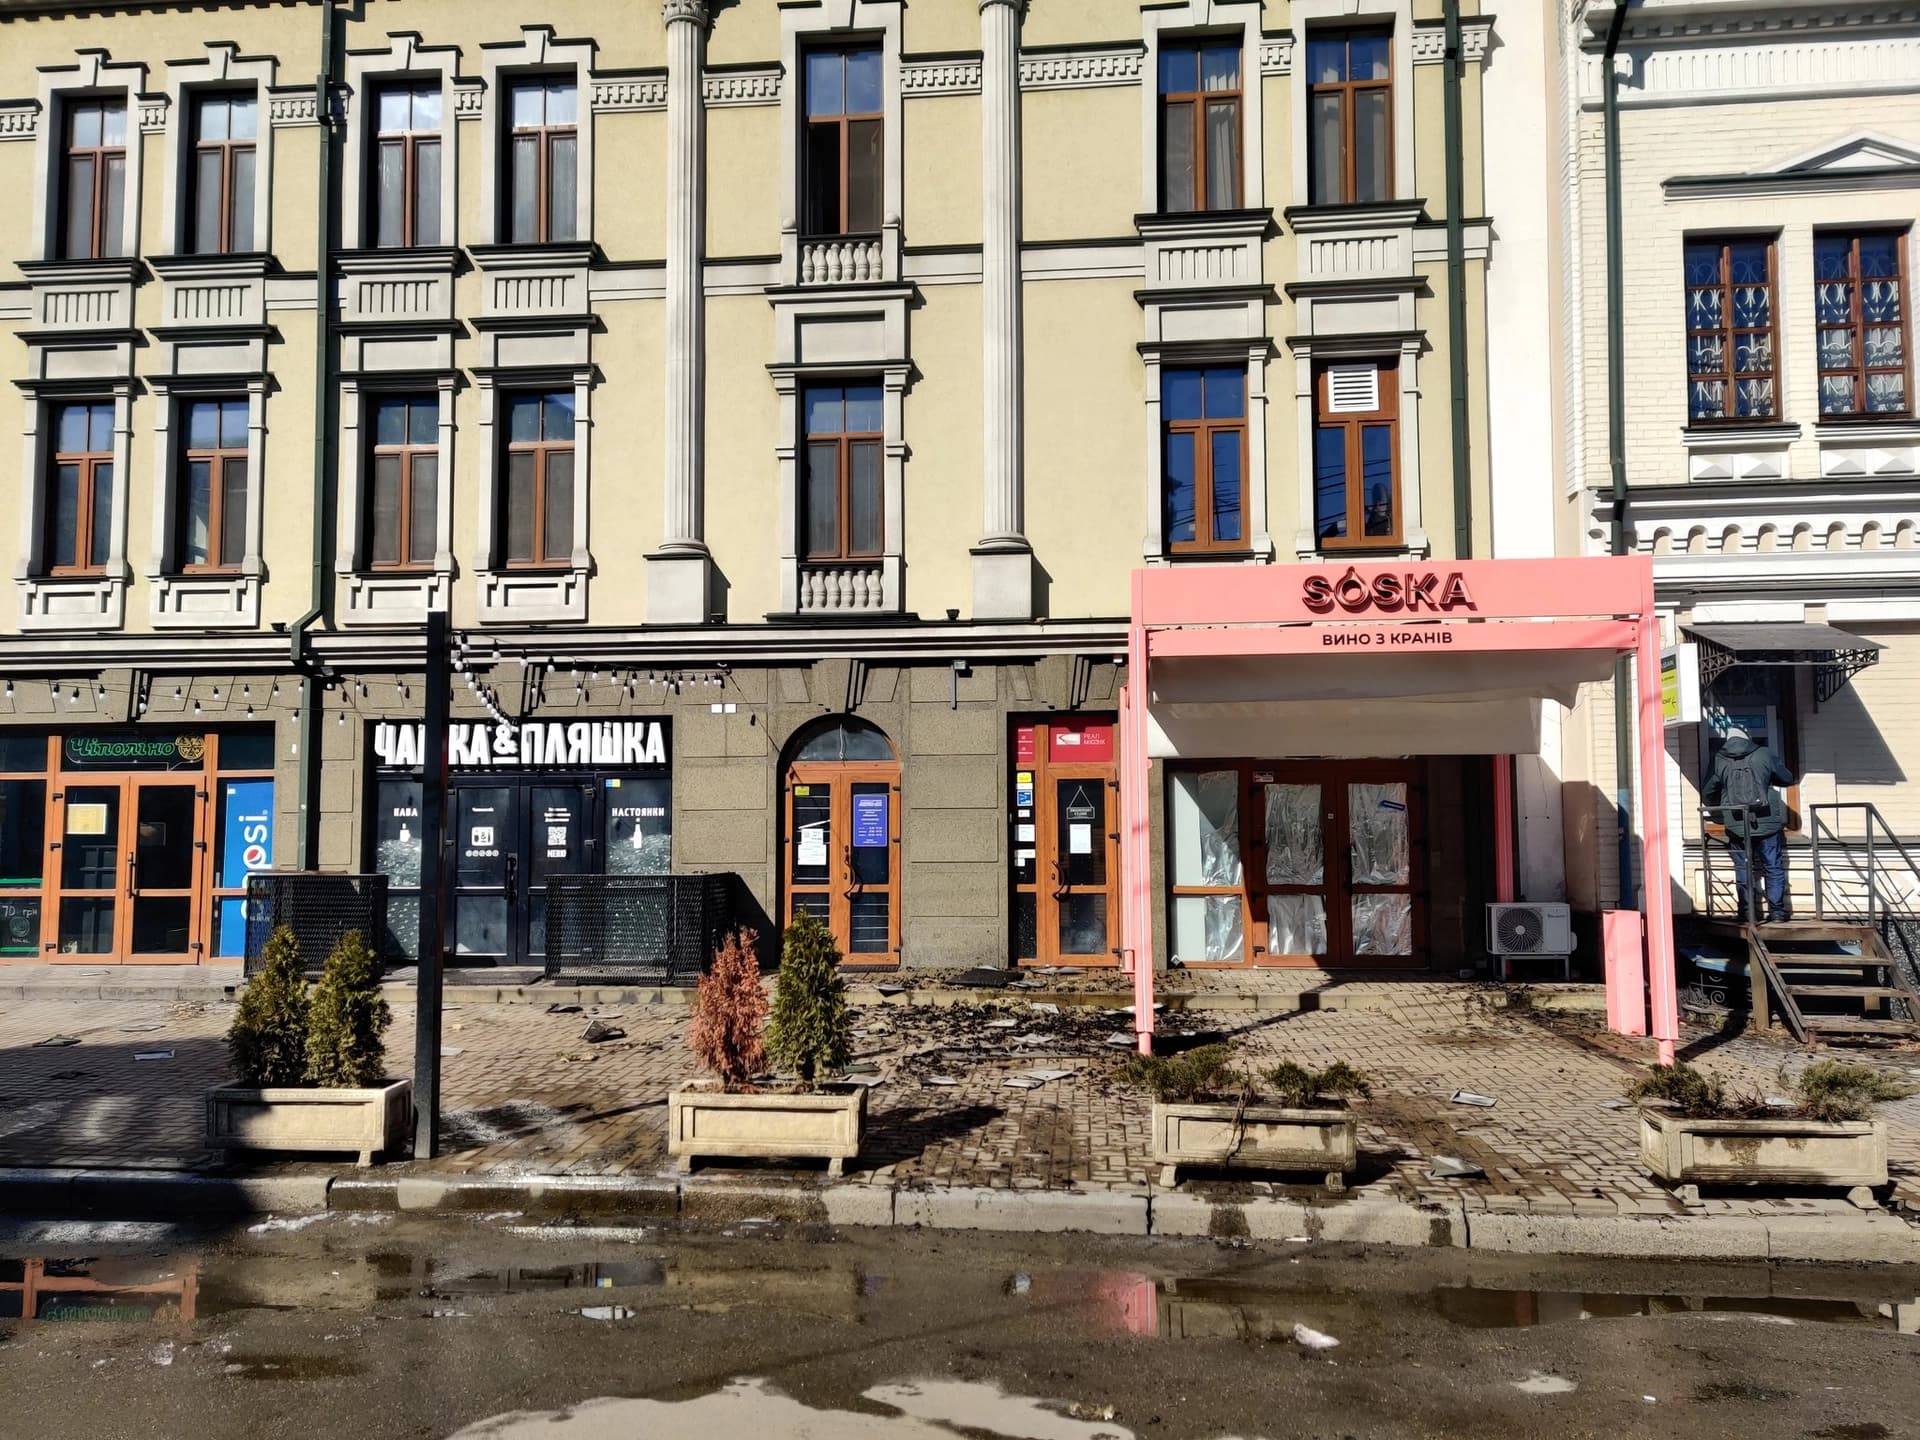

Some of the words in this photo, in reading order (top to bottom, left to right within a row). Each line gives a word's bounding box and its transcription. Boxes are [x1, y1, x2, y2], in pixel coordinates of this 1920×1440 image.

[1323, 633, 1371, 646] ВИНО
[1391, 631, 1453, 644] КРАНІВ
[611, 807, 665, 817] НАСТОЯНКИ
